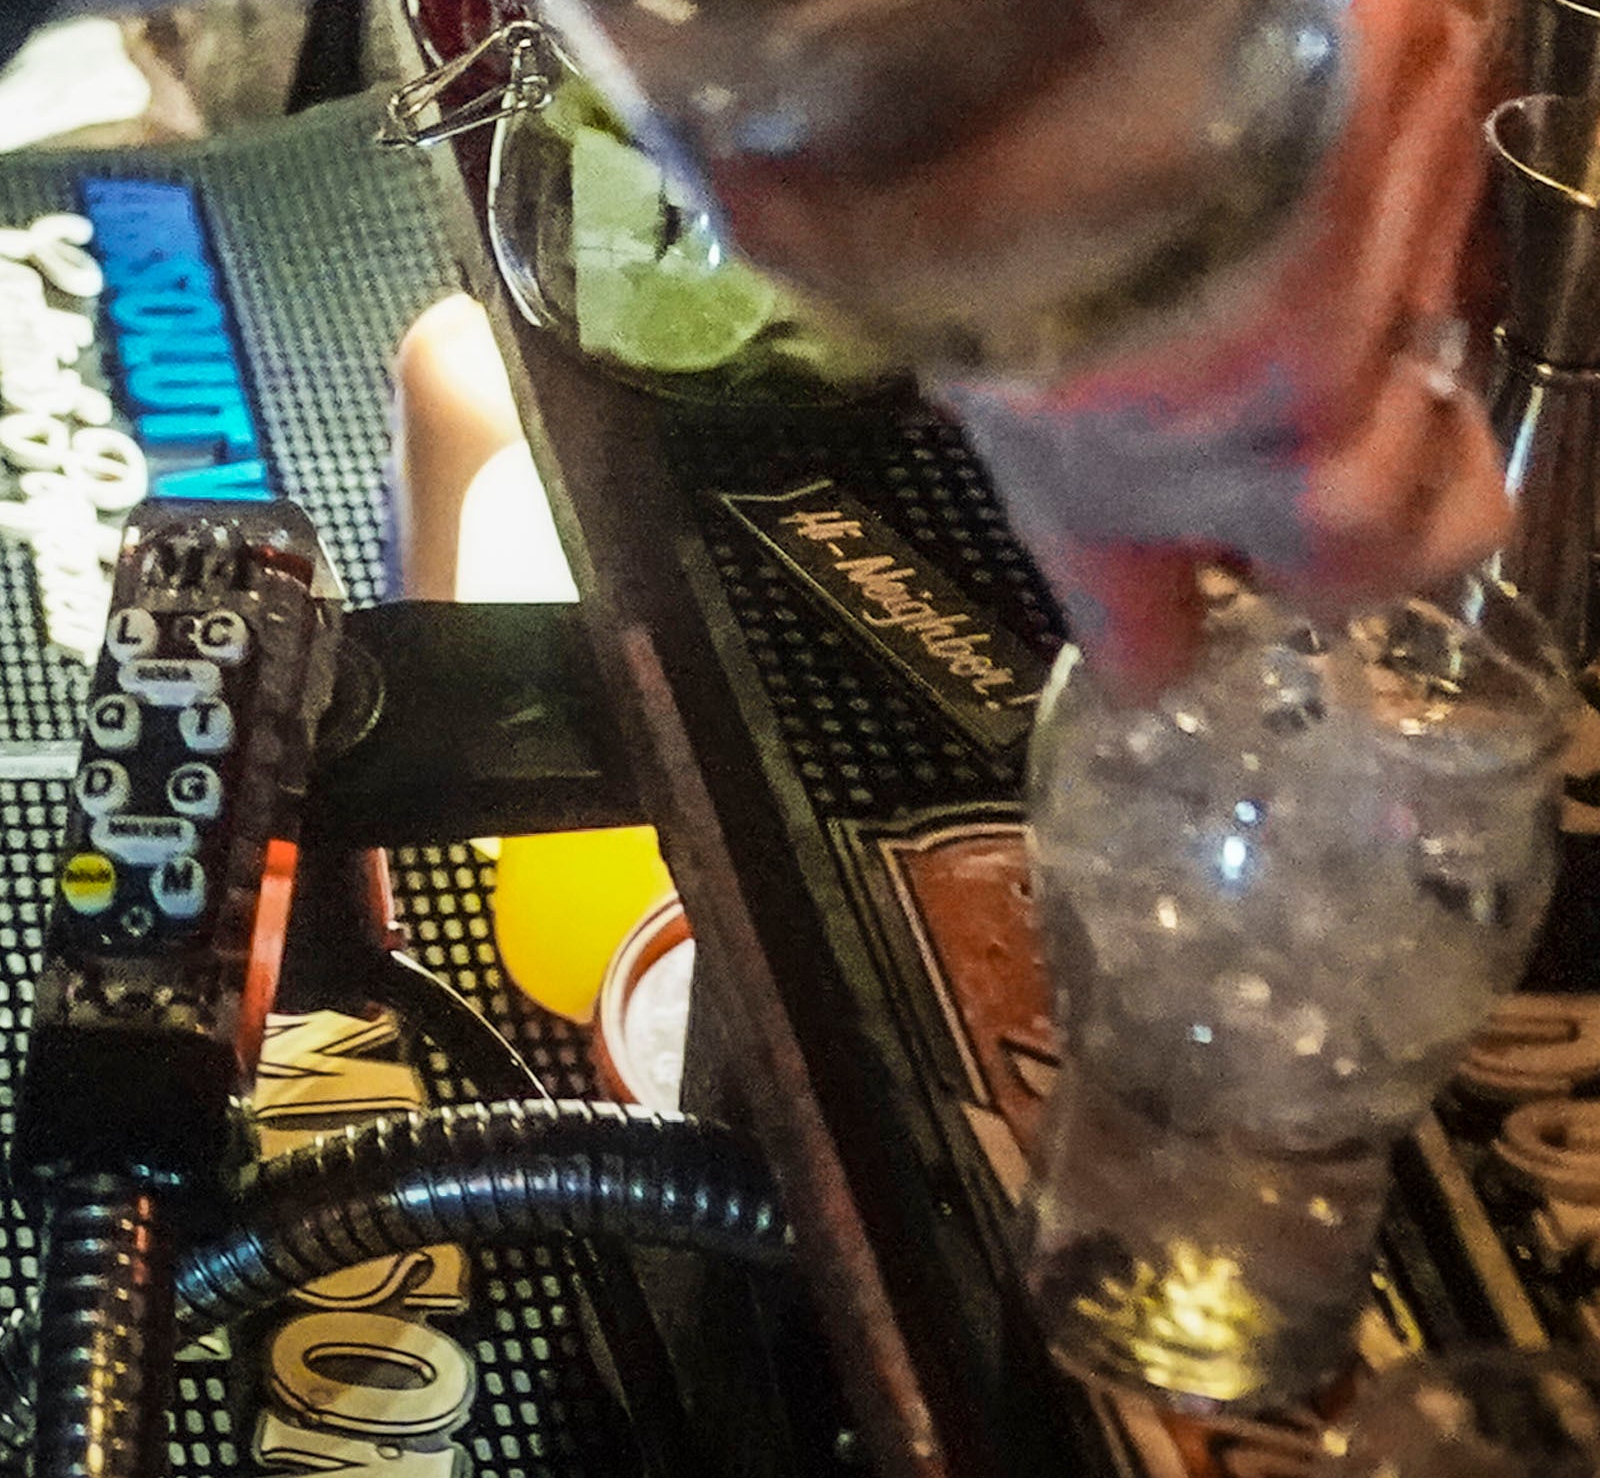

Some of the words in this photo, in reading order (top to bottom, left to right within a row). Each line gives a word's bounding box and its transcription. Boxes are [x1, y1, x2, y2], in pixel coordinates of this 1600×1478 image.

[116, 615, 140, 645] L
[202, 616, 234, 646] C
[191, 701, 219, 735] T
[85, 766, 112, 797] D
[162, 859, 194, 892] M
